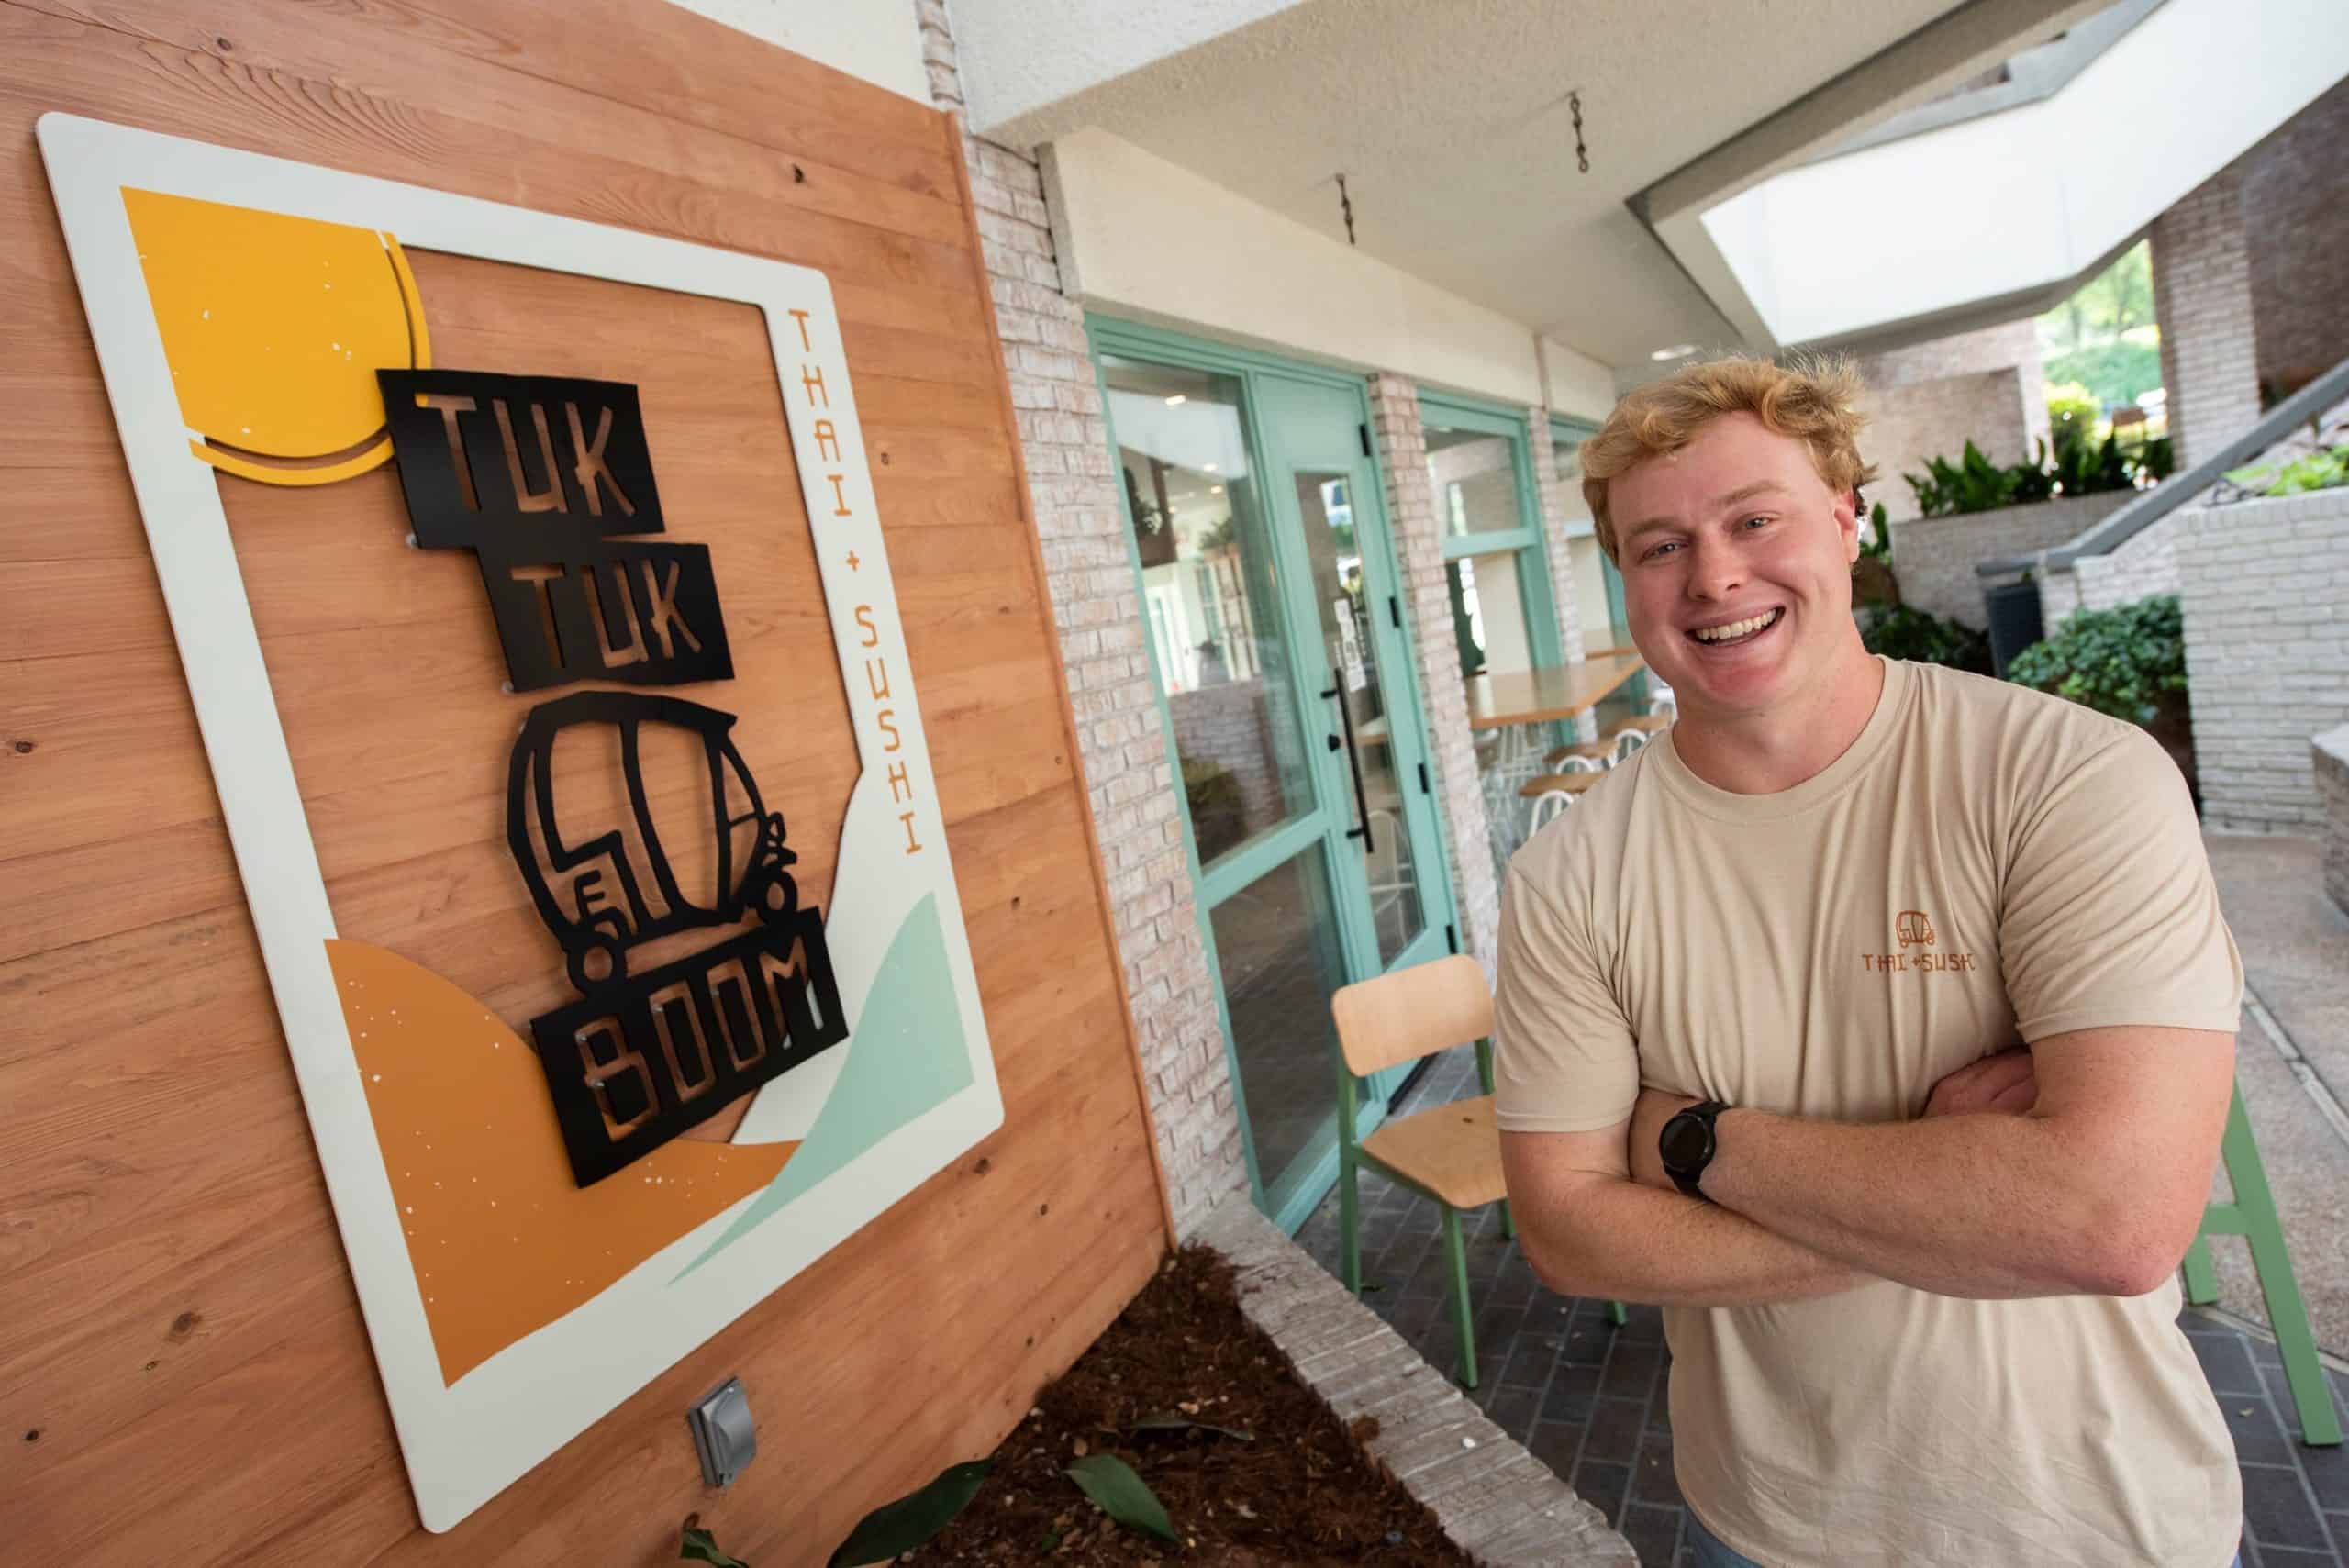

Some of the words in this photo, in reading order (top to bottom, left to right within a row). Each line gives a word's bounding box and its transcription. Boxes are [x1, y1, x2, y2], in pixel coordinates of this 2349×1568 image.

[415, 392, 636, 517] TUK
[511, 558, 702, 668] TUK
[788, 308, 852, 516] THAI
[854, 605, 922, 854] SUSHI
[574, 934, 824, 1142] BOOM
